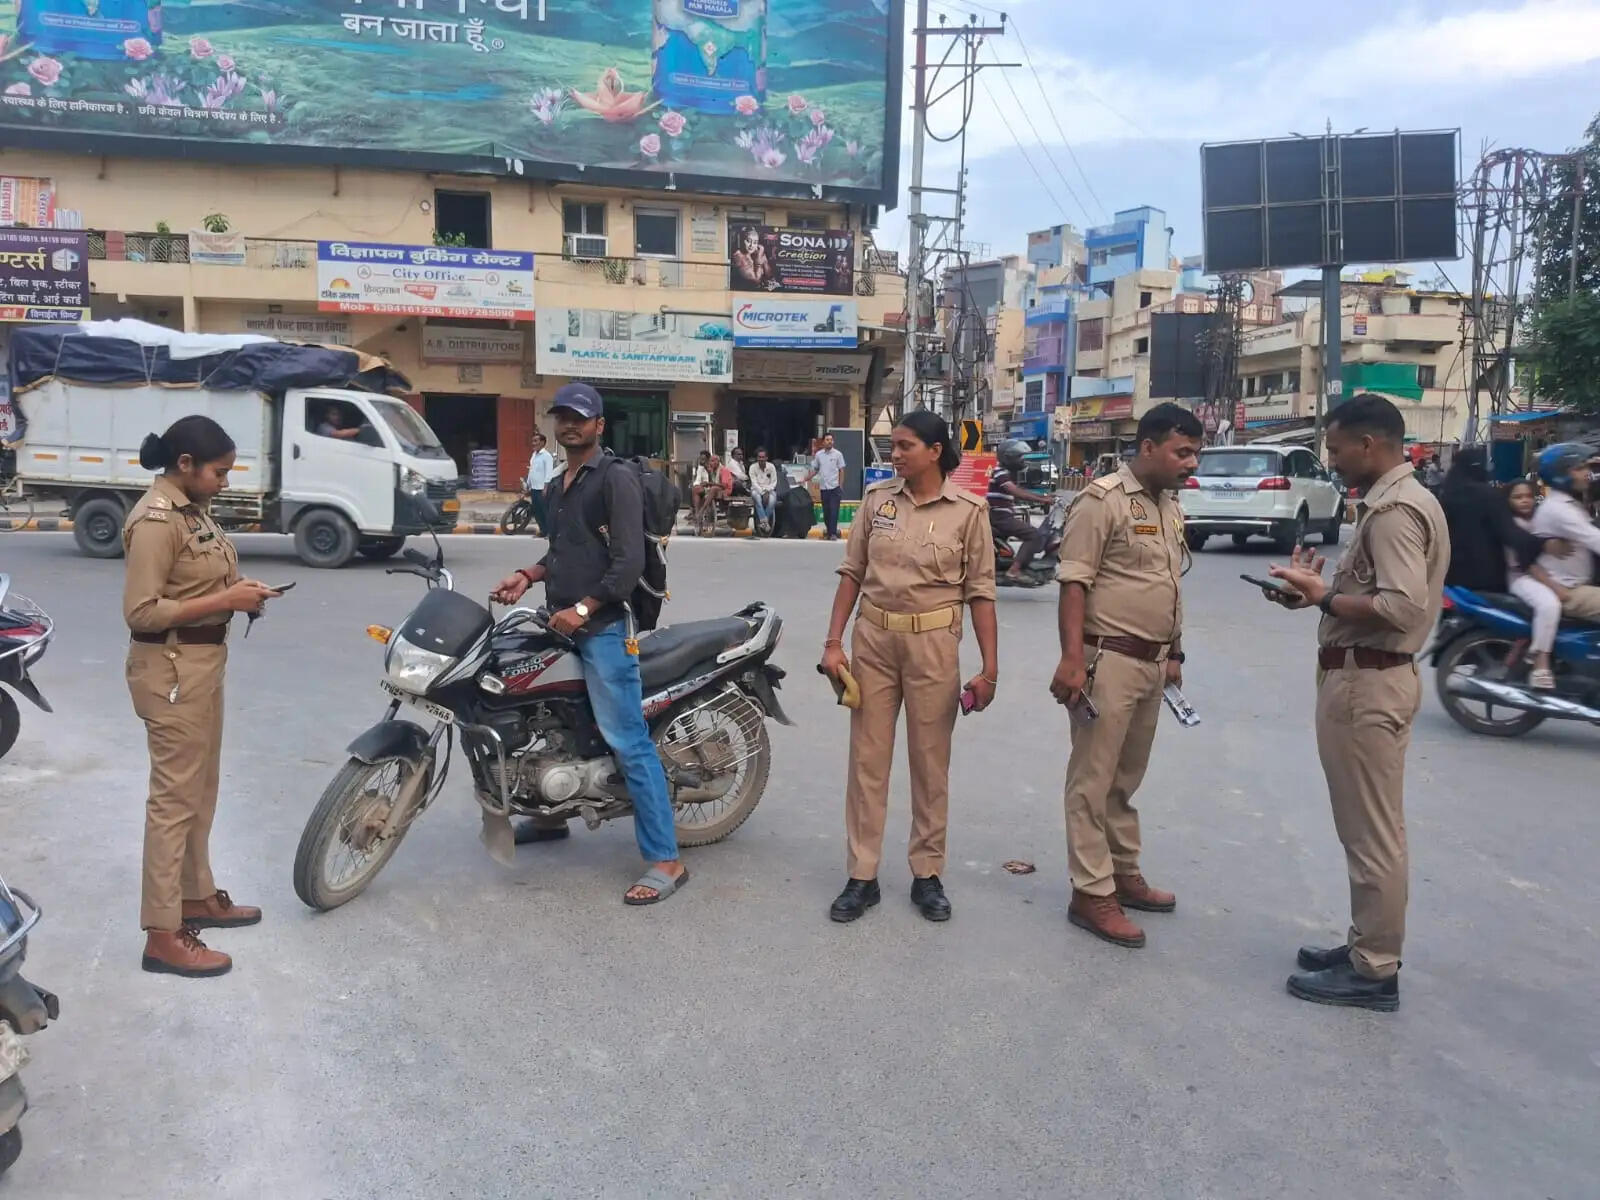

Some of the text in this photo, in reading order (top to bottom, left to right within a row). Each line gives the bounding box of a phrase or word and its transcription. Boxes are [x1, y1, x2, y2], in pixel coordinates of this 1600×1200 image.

[341, 13, 490, 52] बन जाता हूँ
[37, 97, 46, 107] के
[48, 97, 67, 110] लिए
[70, 99, 115, 113] हानिकारक
[138, 104, 156, 115] छवि
[158, 106, 181, 117] केवल
[239, 111, 248, 121] के
[250, 112, 267, 123] लिए
[780, 233, 826, 248] SONA
[329, 243, 522, 266] विज्ञापन बुकिंग सेन्टर
[778, 250, 827, 260] Creation
[392, 268, 465, 281] City Office
[10, 276, 29, 287] बिल
[53, 278, 82, 289] स्टीकर
[43, 293, 60, 305] आई
[62, 294, 82, 305] कार्ड
[340, 302, 370, 312] Mob-
[743, 312, 809, 322] MICROTEK
[448, 340, 521, 352] DISTRIBUTORS
[571, 350, 609, 359] PLASTIC
[621, 353, 697, 363] SANITARYWARE
